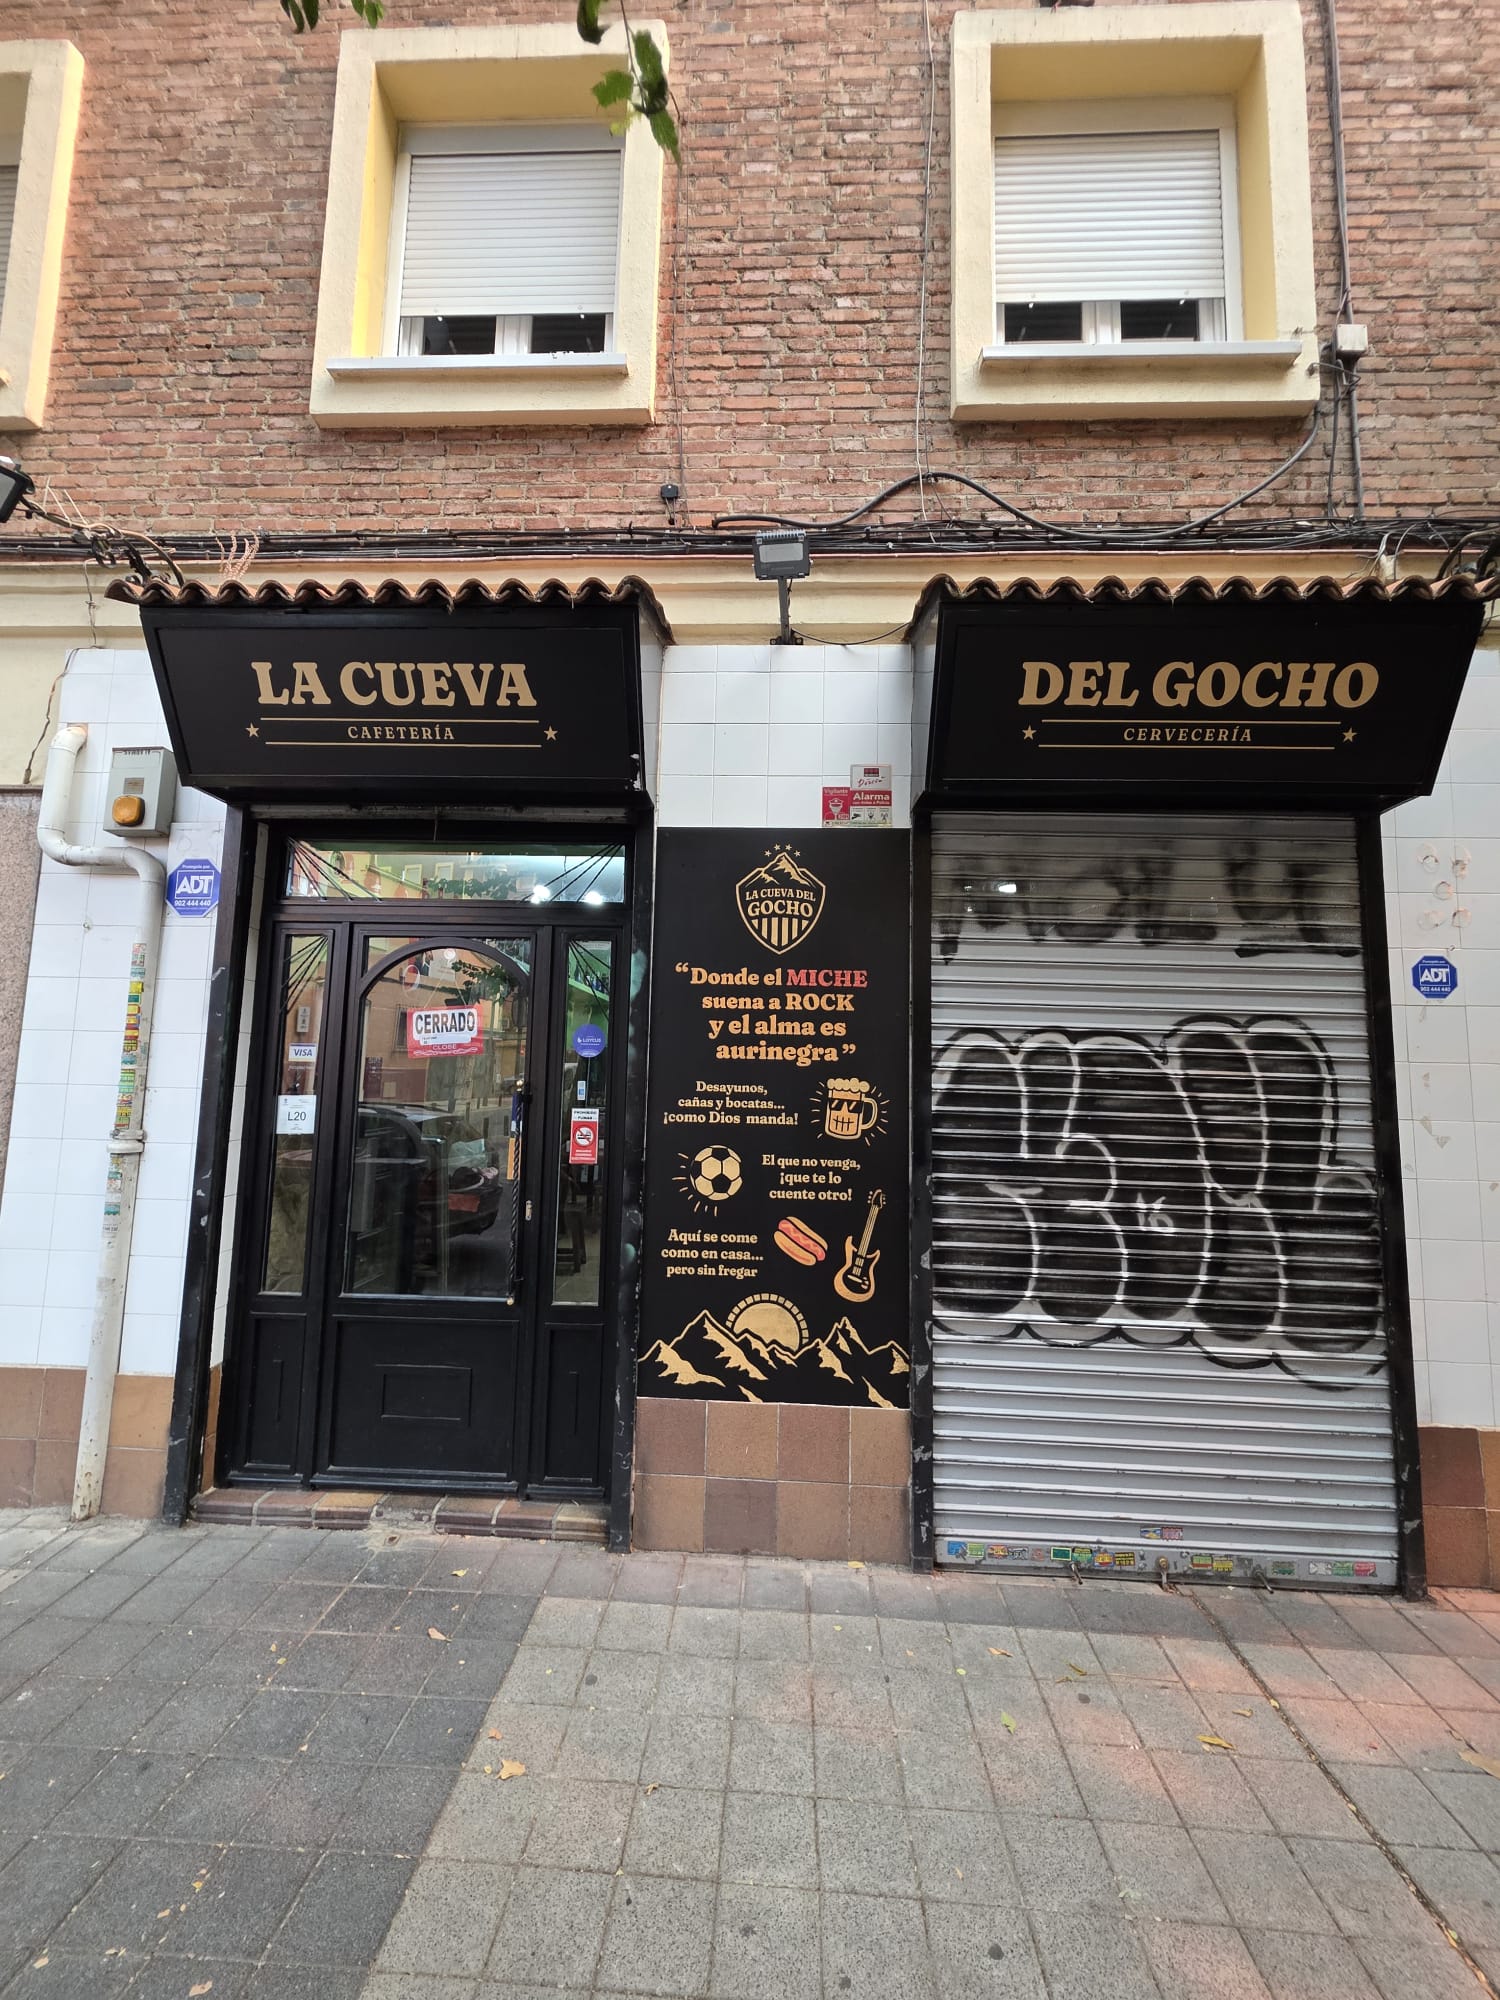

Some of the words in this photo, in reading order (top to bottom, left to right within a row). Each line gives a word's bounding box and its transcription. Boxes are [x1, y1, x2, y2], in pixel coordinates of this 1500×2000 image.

[250, 661, 332, 706] LA
[339, 661, 538, 707] CUEVA
[1018, 661, 1140, 707] DEL
[1152, 661, 1380, 708] GOCHO
[347, 724, 455, 740] CAFETERÍA
[1123, 725, 1252, 742] CERVECERÍA
[853, 792, 890, 801] Alarma
[176, 875, 213, 894] ADT
[745, 890, 758, 901] LA
[760, 888, 795, 898] CUEVA
[795, 890, 816, 902] DEL
[747, 900, 814, 918] GOCHO
[675, 962, 760, 986] “Donde
[763, 968, 782, 986] el
[786, 969, 868, 988] MICHE
[1420, 968, 1449, 983] ADT
[702, 996, 765, 1009] suena
[768, 998, 782, 1010] a
[784, 993, 855, 1011] ROCK
[415, 1011, 474, 1034] CERRADO
[708, 1020, 725, 1039] y
[728, 1014, 750, 1034] el
[754, 1014, 816, 1036] alma
[819, 1022, 847, 1037] es
[294, 1048, 312, 1056] VISA
[715, 1040, 857, 1067] aurinegra”
[695, 1080, 768, 1096] Desayunos,
[677, 1097, 714, 1108] cañas
[715, 1099, 724, 1111] y
[725, 1097, 785, 1110] bocatas...
[287, 1111, 307, 1121] L20
[663, 1112, 707, 1125] ¡como
[708, 1111, 741, 1124] Dios
[746, 1112, 799, 1126] manda!
[761, 1154, 776, 1166] El
[777, 1158, 800, 1169] que
[802, 1158, 818, 1167] no
[820, 1158, 861, 1171] venga,
[779, 1172, 810, 1186] ¡que
[812, 1173, 826, 1184] te
[828, 1171, 842, 1185] lo
[769, 1189, 816, 1200] cuente
[818, 1189, 853, 1202] otro!
[667, 1228, 702, 1245] Aquí
[703, 1233, 718, 1243] se
[720, 1233, 758, 1244] come
[661, 1248, 699, 1259] como
[701, 1249, 719, 1260] en
[720, 1250, 764, 1261] casa...
[666, 1266, 695, 1278] pero
[697, 1264, 717, 1276] sin
[718, 1265, 758, 1279] fregar
